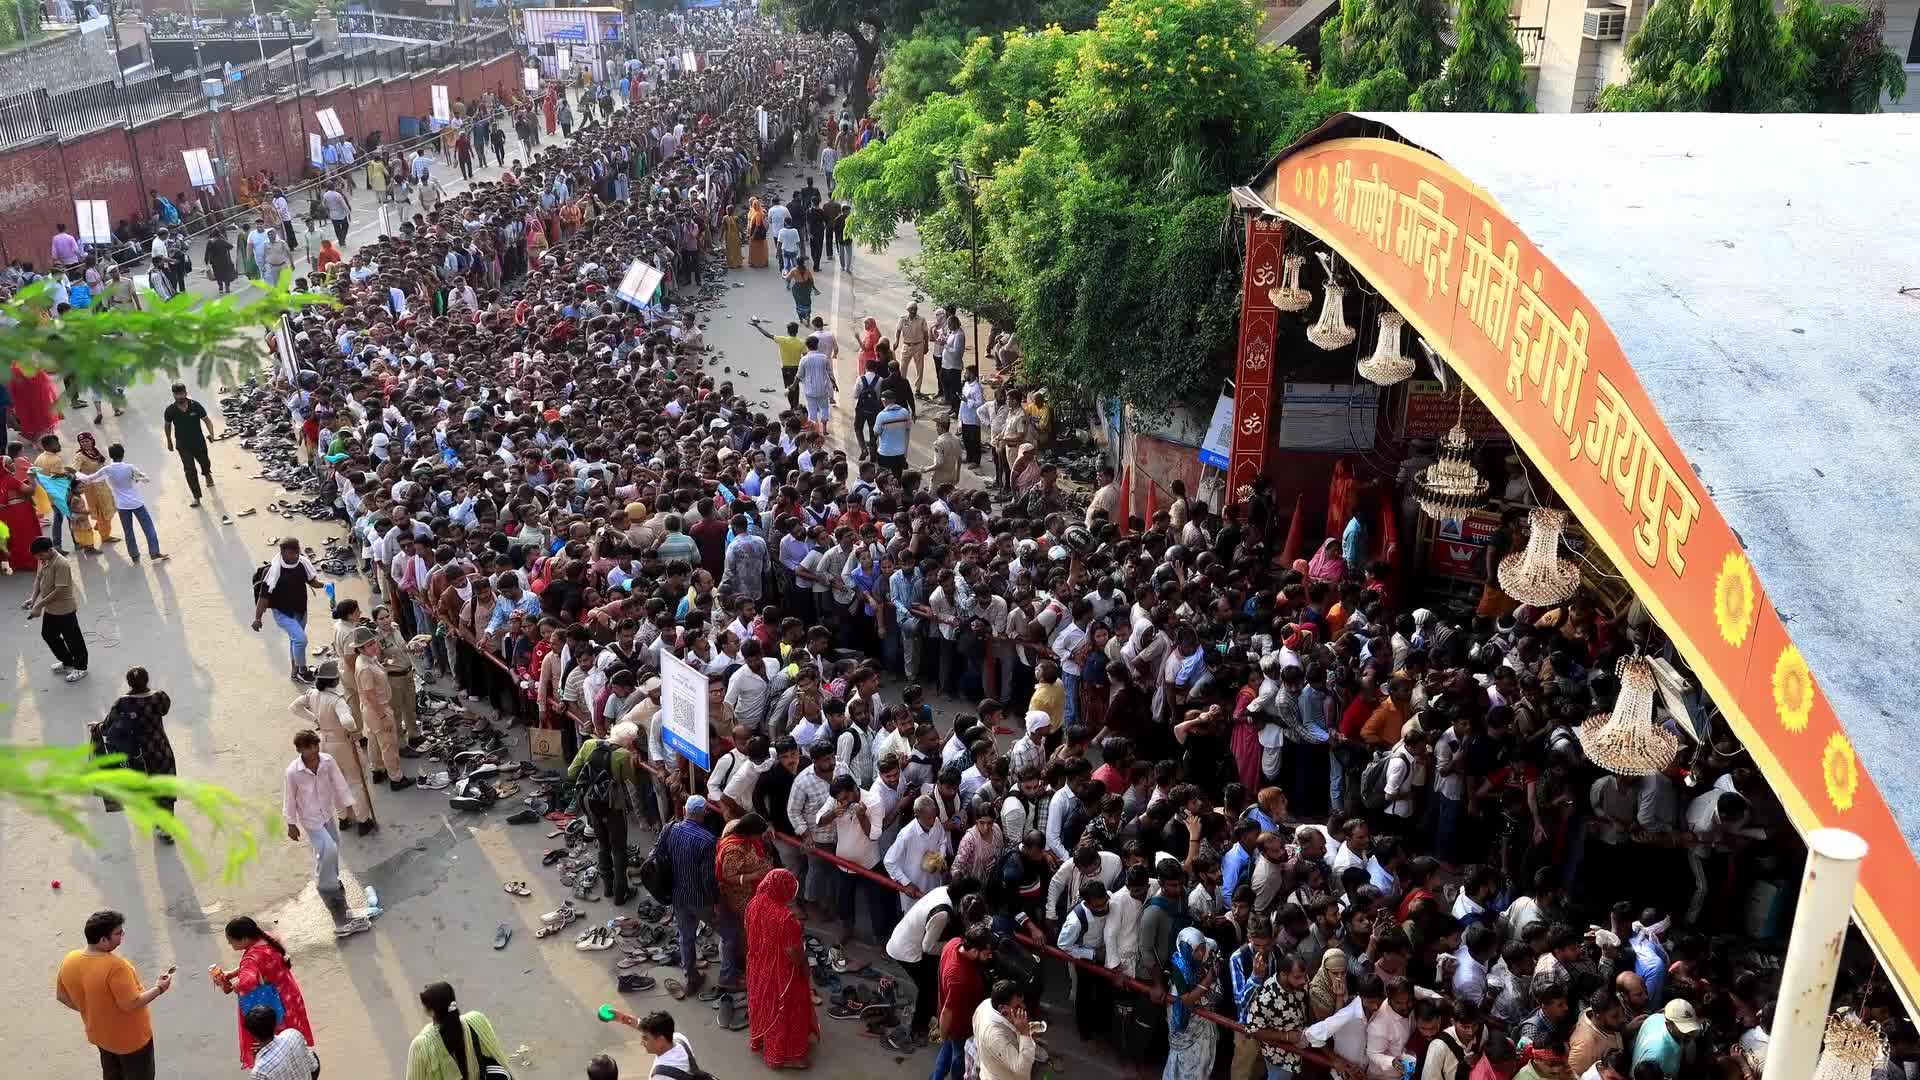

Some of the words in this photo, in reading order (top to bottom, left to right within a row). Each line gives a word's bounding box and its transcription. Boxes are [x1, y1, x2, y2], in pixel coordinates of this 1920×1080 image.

[1333, 160, 1351, 224] श्री
[1352, 161, 1397, 254] गणेश
[1459, 217, 1520, 353] मोती
[1584, 370, 1701, 579] जयपुर
